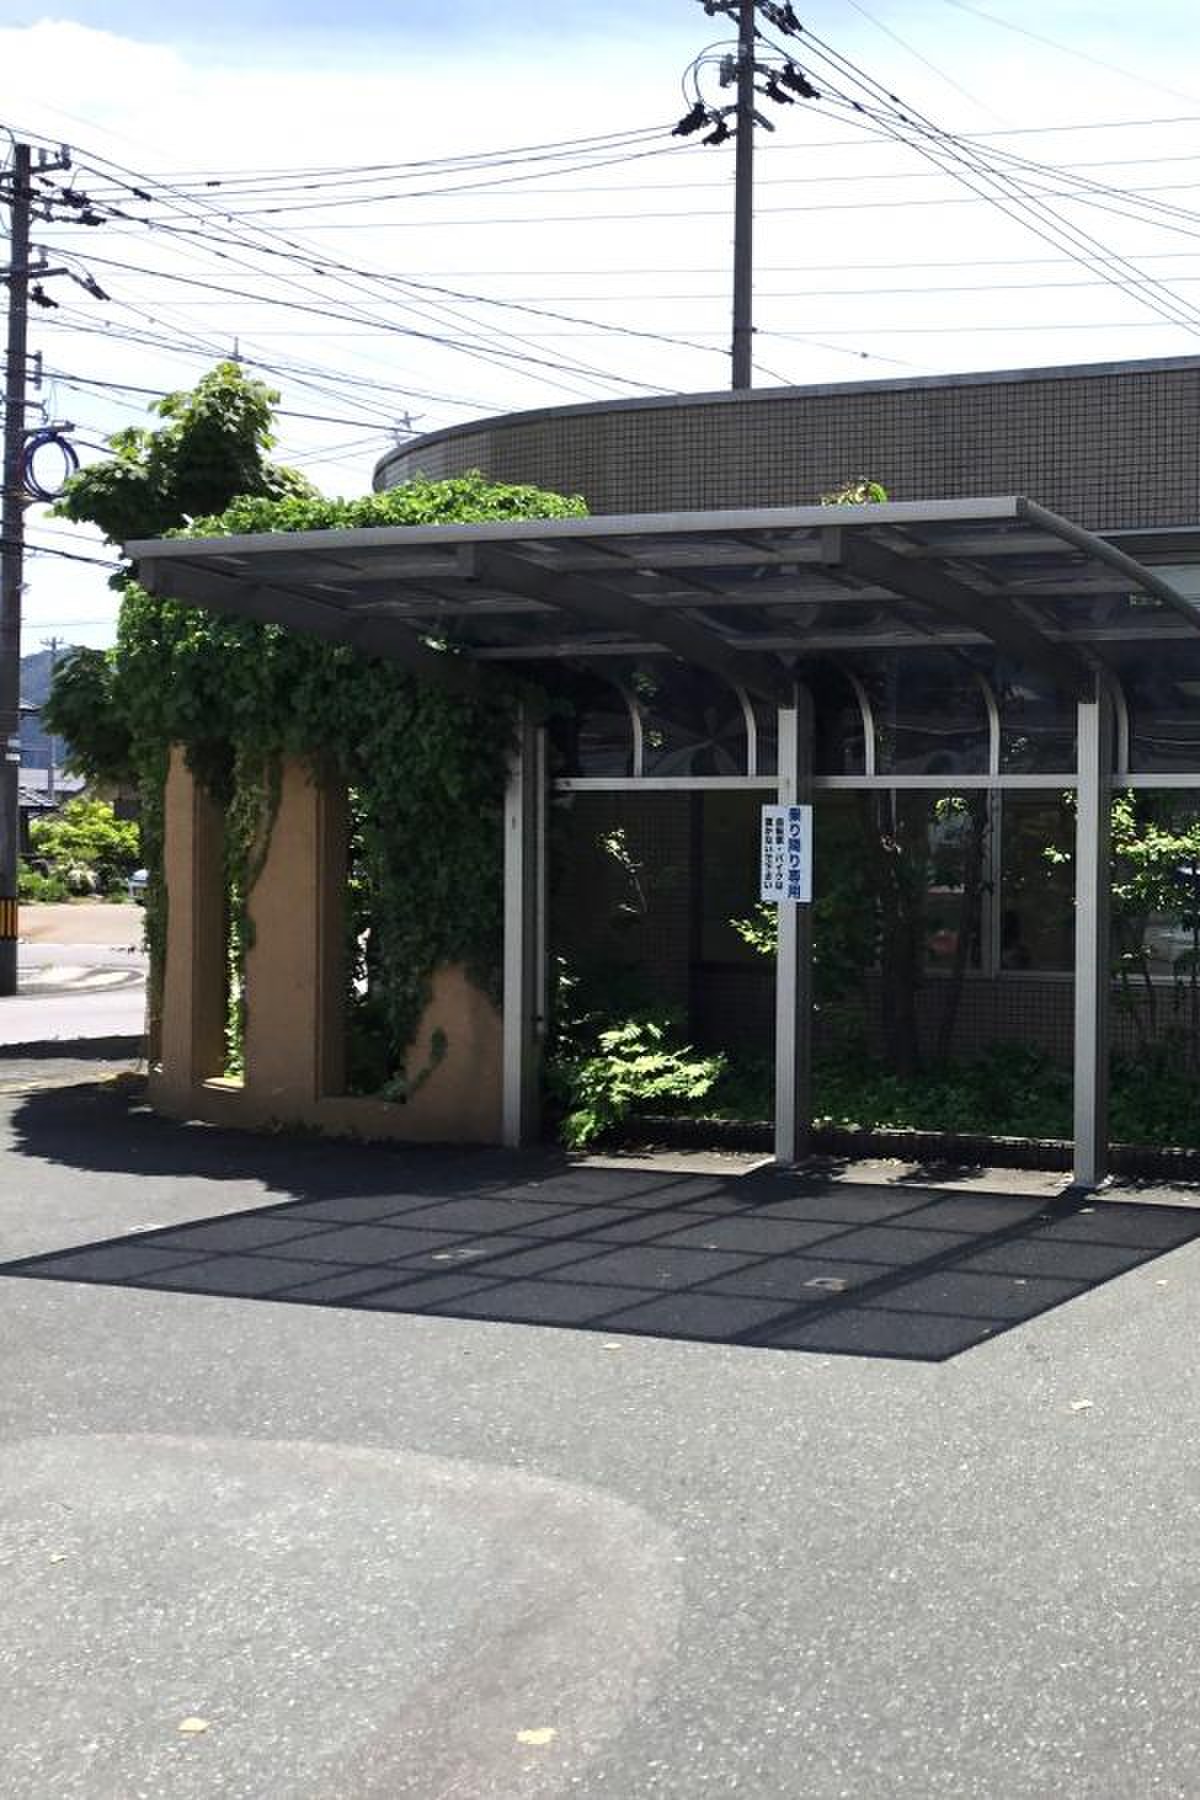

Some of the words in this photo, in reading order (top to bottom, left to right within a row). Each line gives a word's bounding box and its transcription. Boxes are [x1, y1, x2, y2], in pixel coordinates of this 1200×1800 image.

[788, 807, 801, 899] 乗り降り専用
